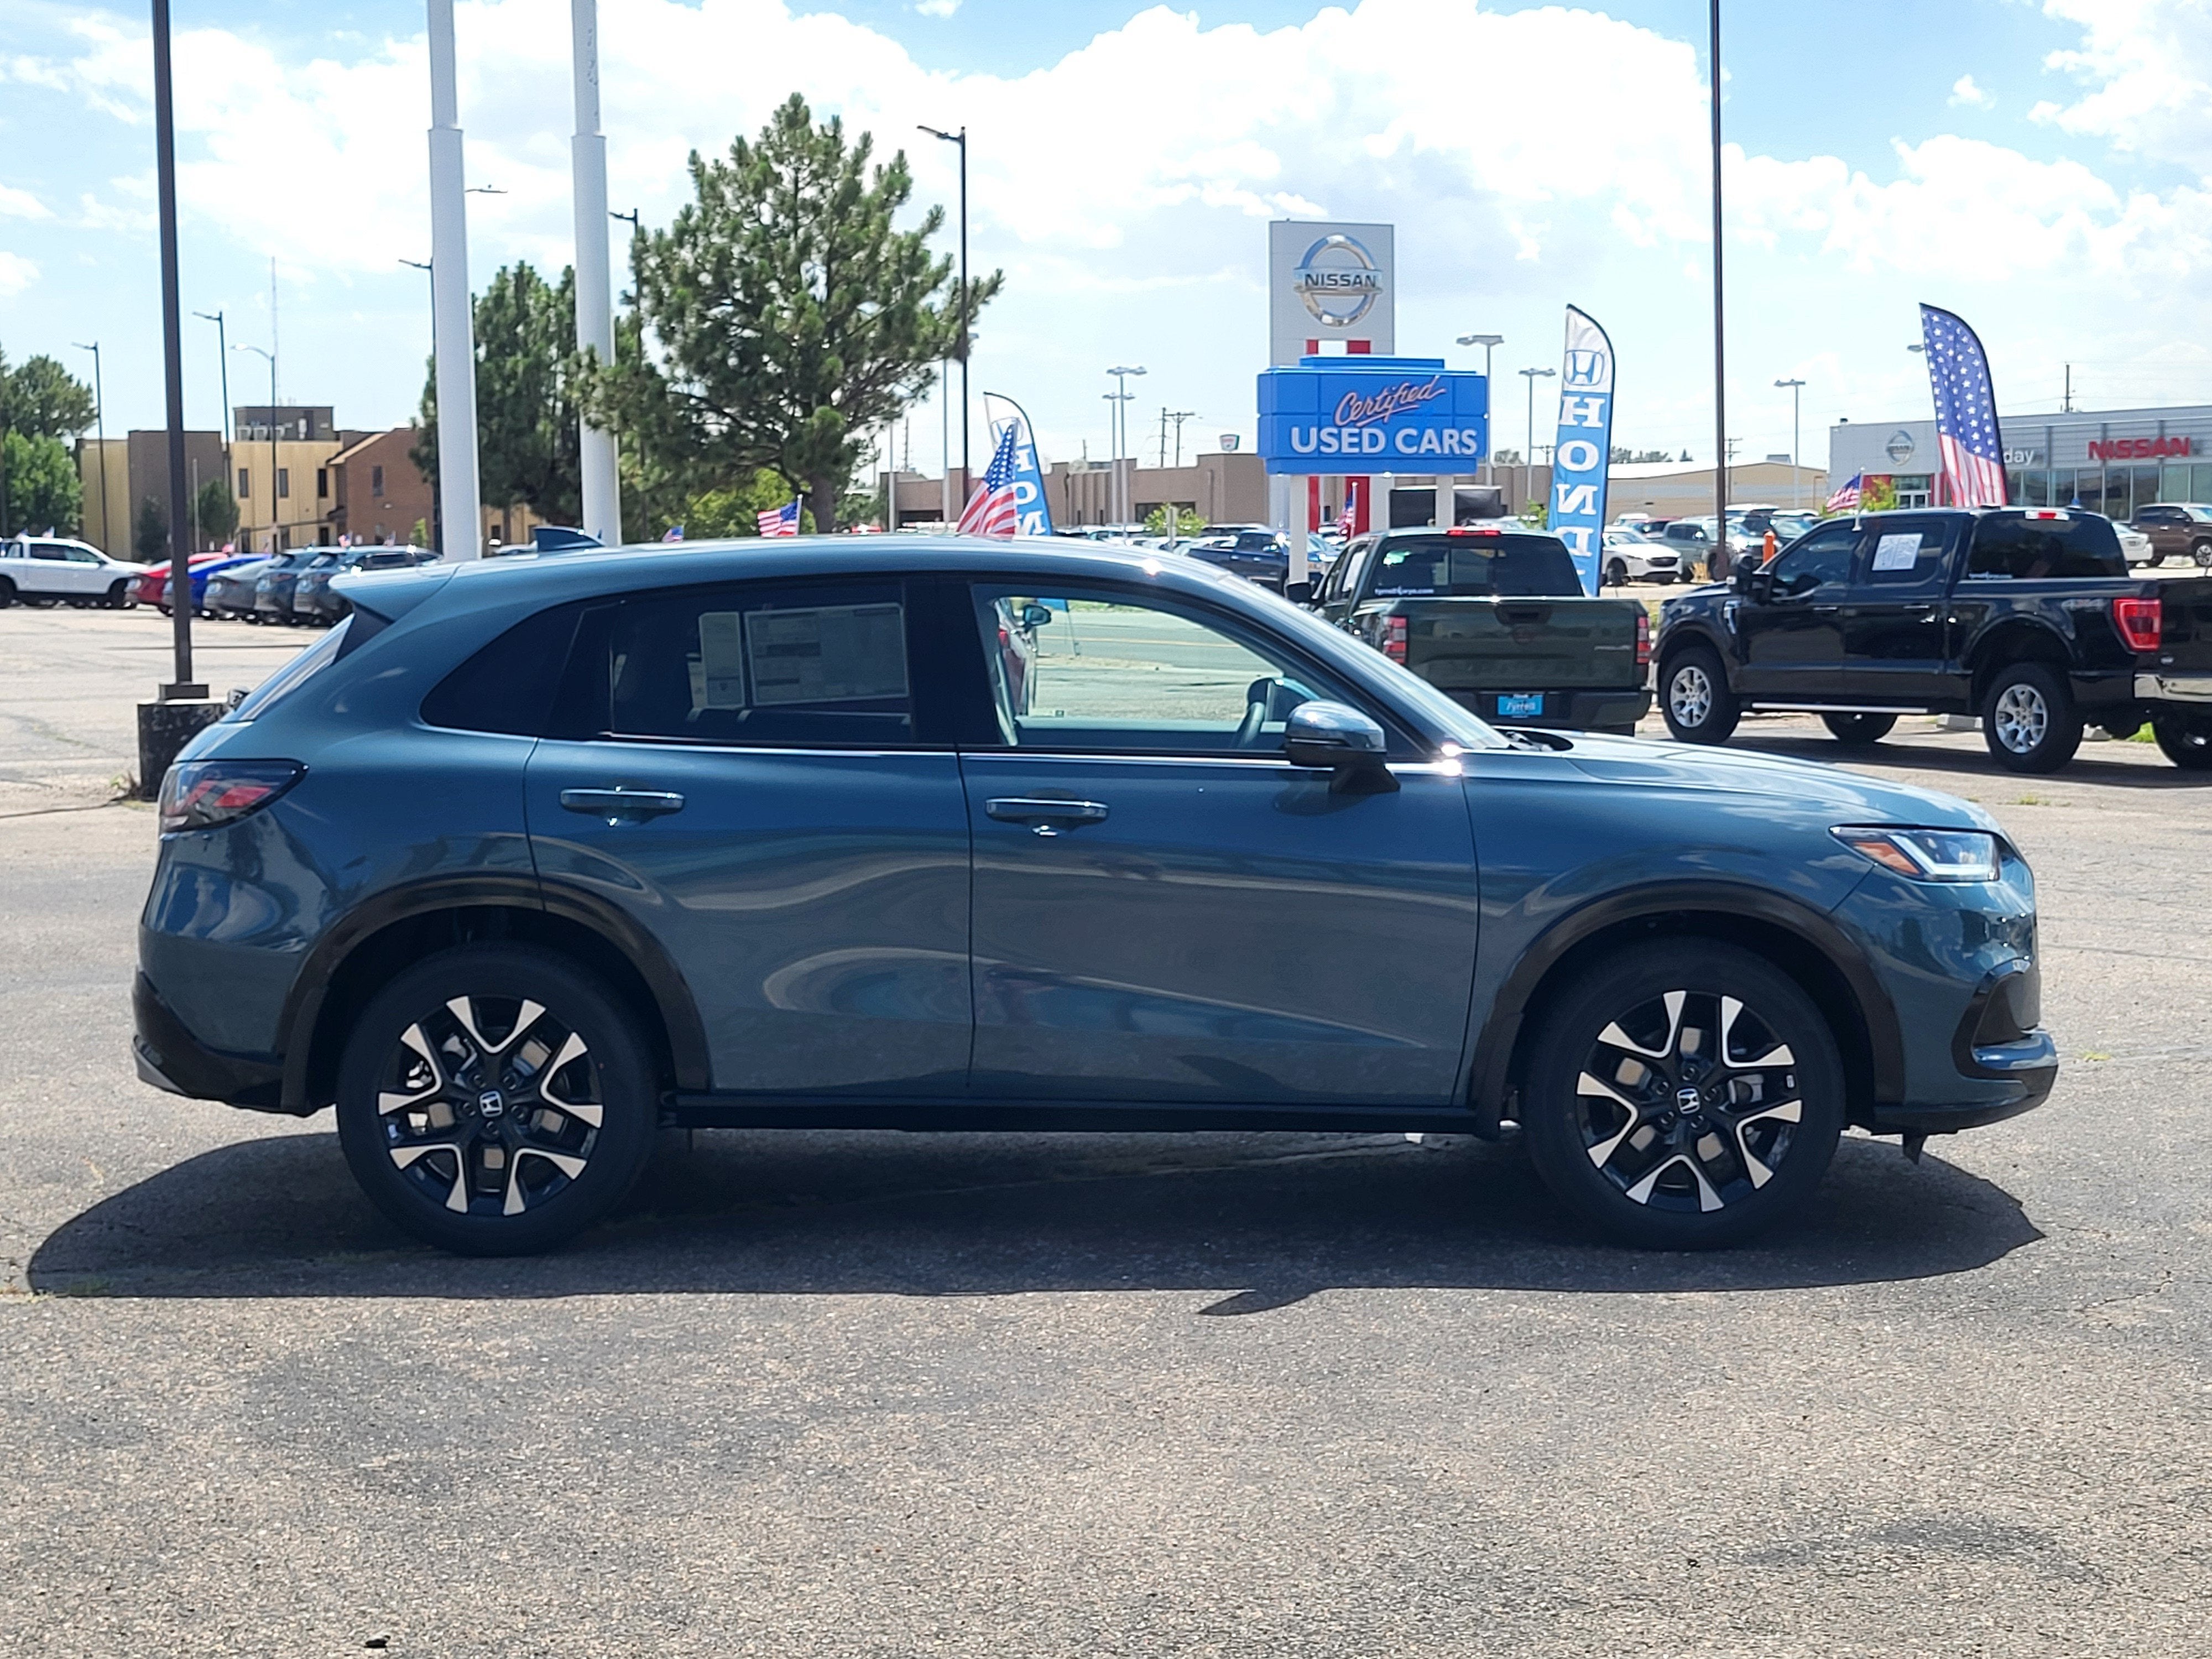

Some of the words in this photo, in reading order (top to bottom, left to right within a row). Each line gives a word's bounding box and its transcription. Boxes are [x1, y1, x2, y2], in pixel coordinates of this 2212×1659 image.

[1305, 273, 1376, 288] NISSAN
[1335, 375, 1446, 426] Certified
[1291, 427, 1386, 453] USED
[1395, 427, 1478, 455] CARS
[2088, 436, 2190, 460] NISSAN
